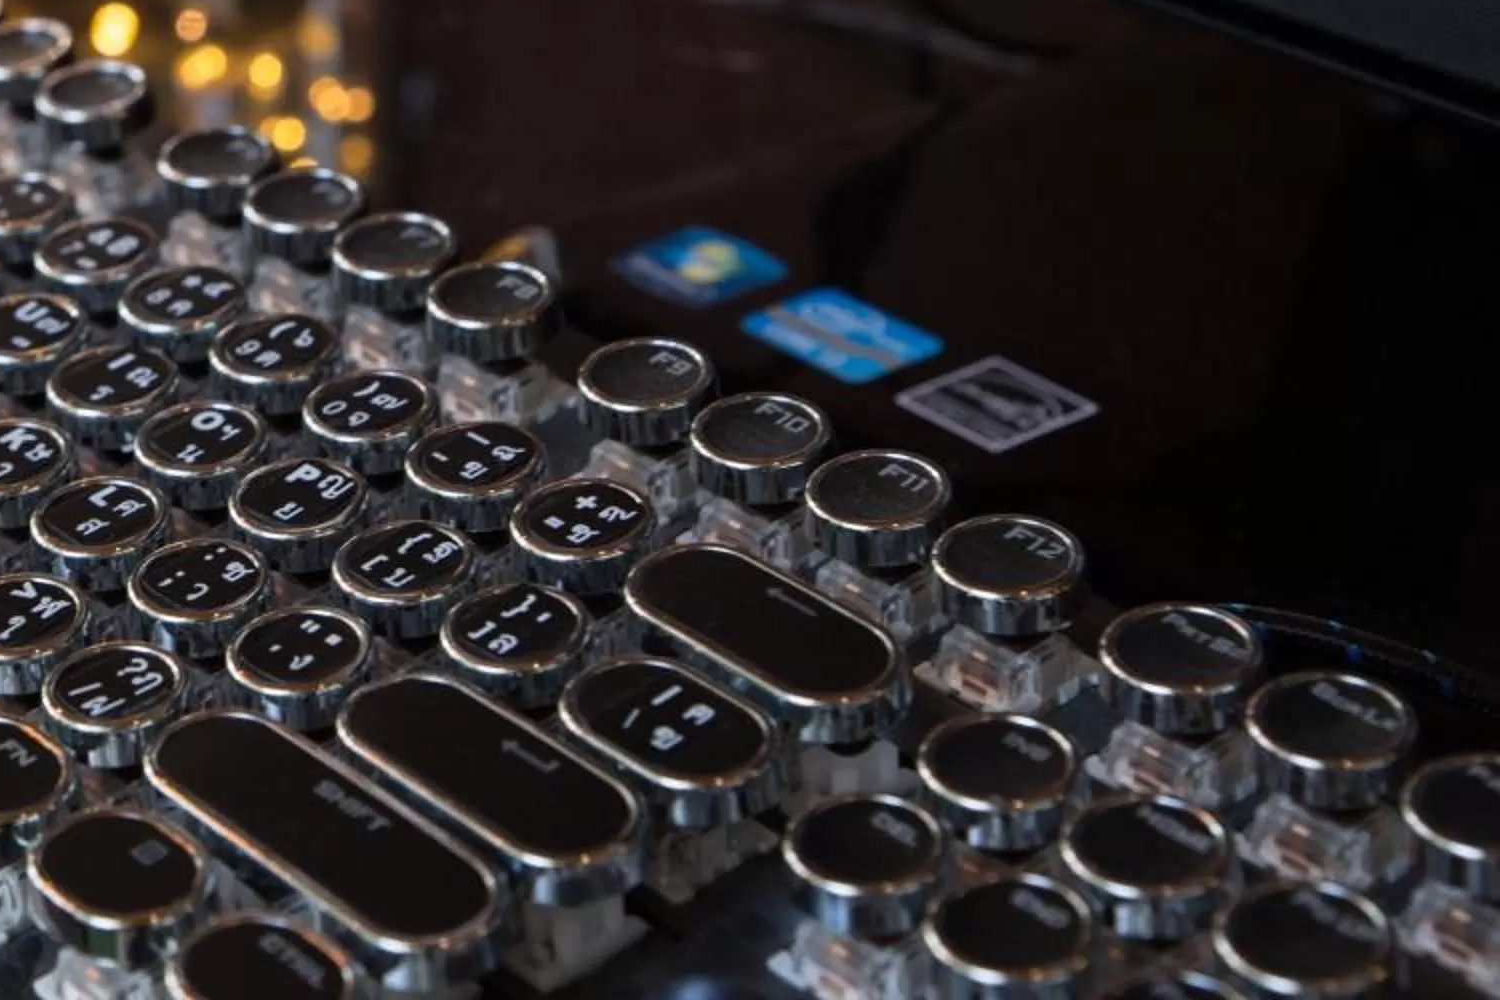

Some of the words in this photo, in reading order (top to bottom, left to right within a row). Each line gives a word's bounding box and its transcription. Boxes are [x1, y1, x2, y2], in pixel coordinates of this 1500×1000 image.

[650, 350, 693, 376] F9
[755, 401, 810, 433] F10
[284, 464, 323, 483] P
[878, 463, 929, 491] F11
[89, 486, 117, 508] L
[1003, 526, 1066, 560] F12
